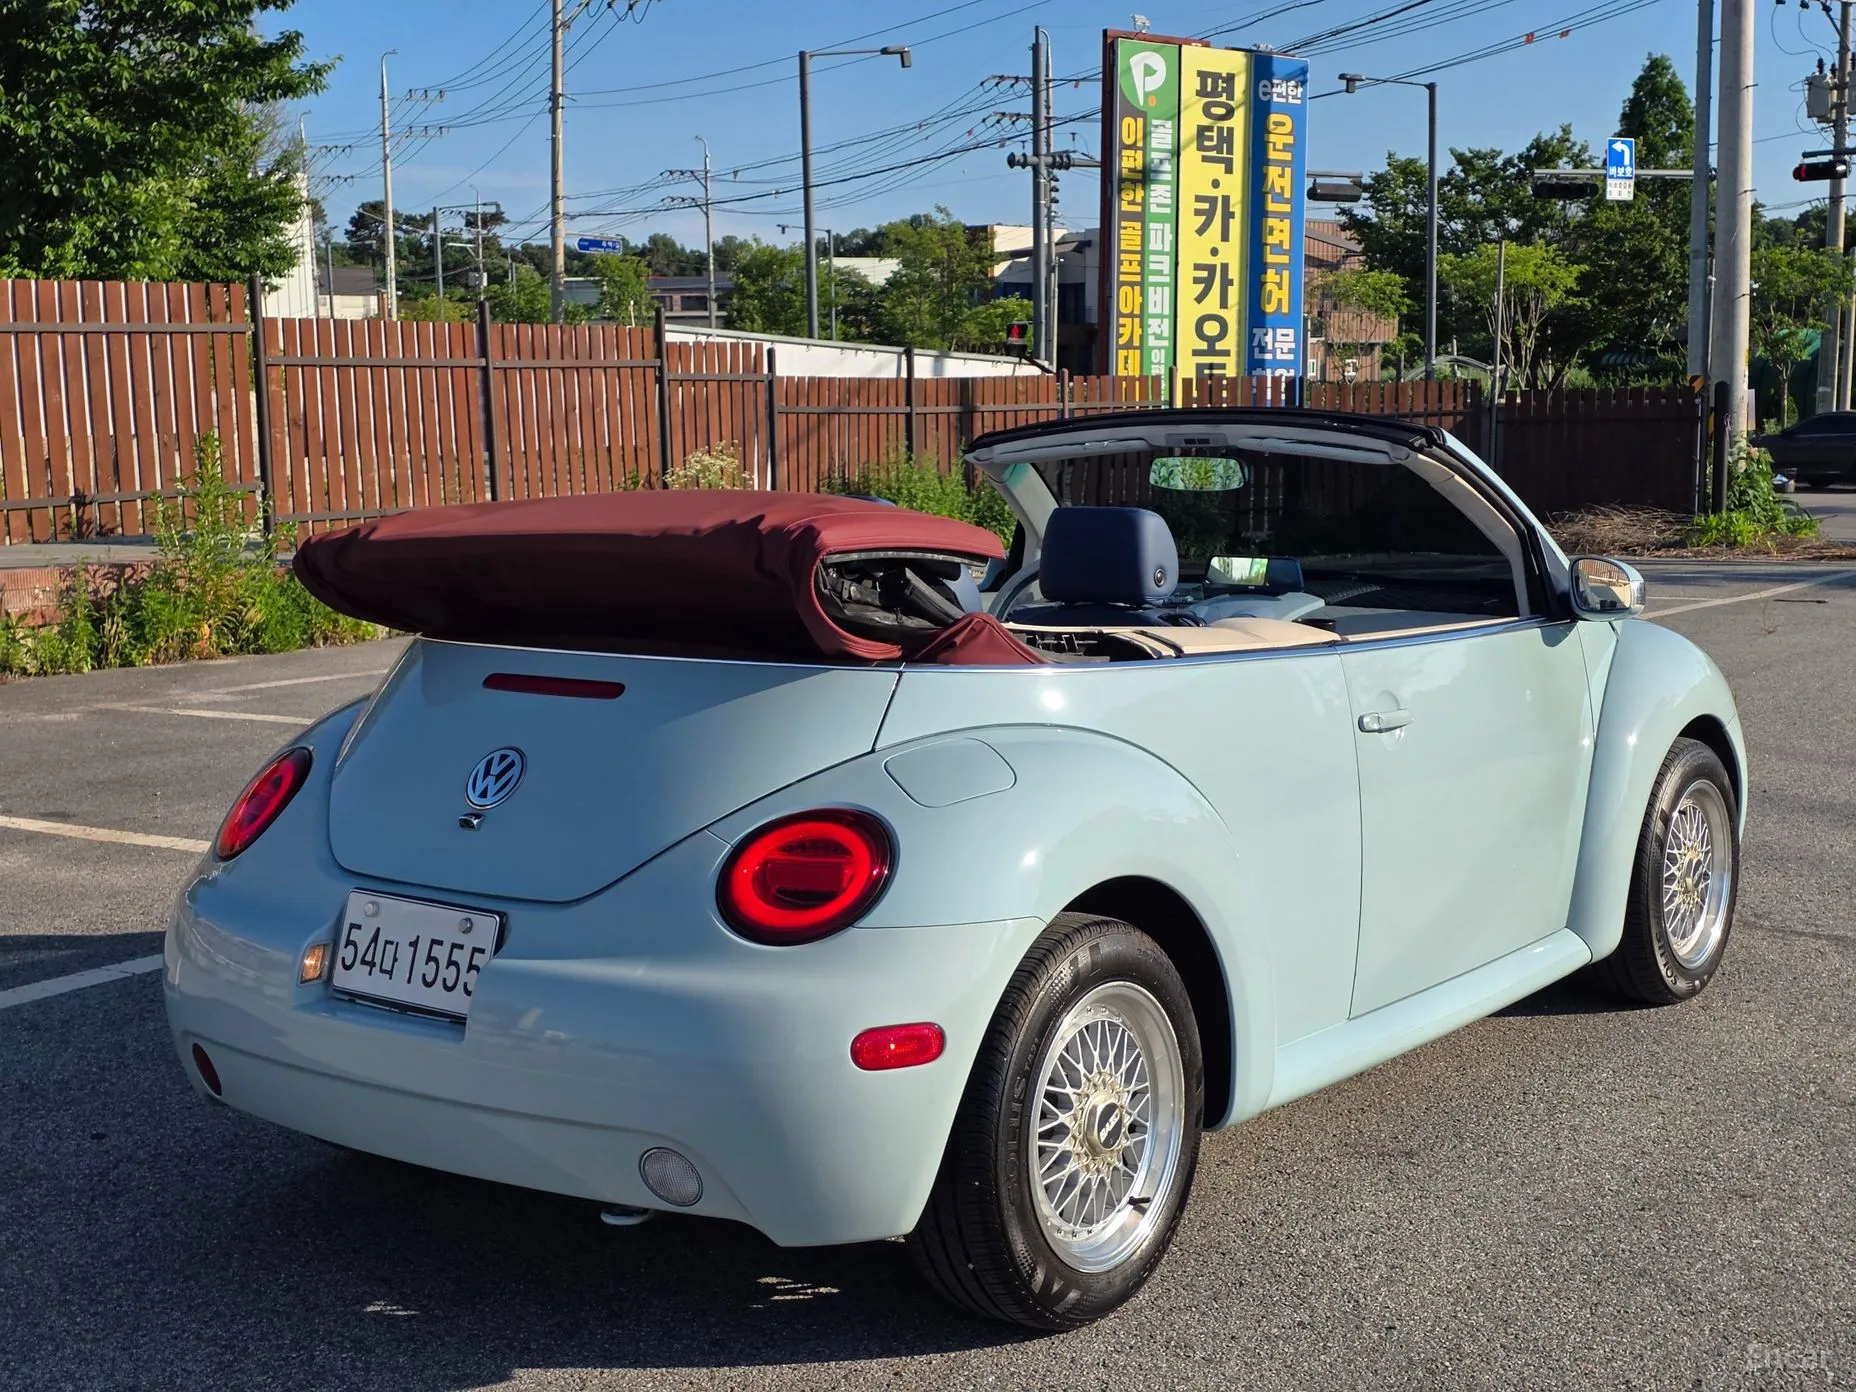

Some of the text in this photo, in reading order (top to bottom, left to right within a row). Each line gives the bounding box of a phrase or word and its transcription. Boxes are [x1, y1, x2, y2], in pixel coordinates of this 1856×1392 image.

[1261, 113, 1294, 313] 운전면허
[1608, 165, 1633, 177] 비보호
[1117, 221, 1143, 401] 골프아카데
[1252, 328, 1295, 360] 전문
